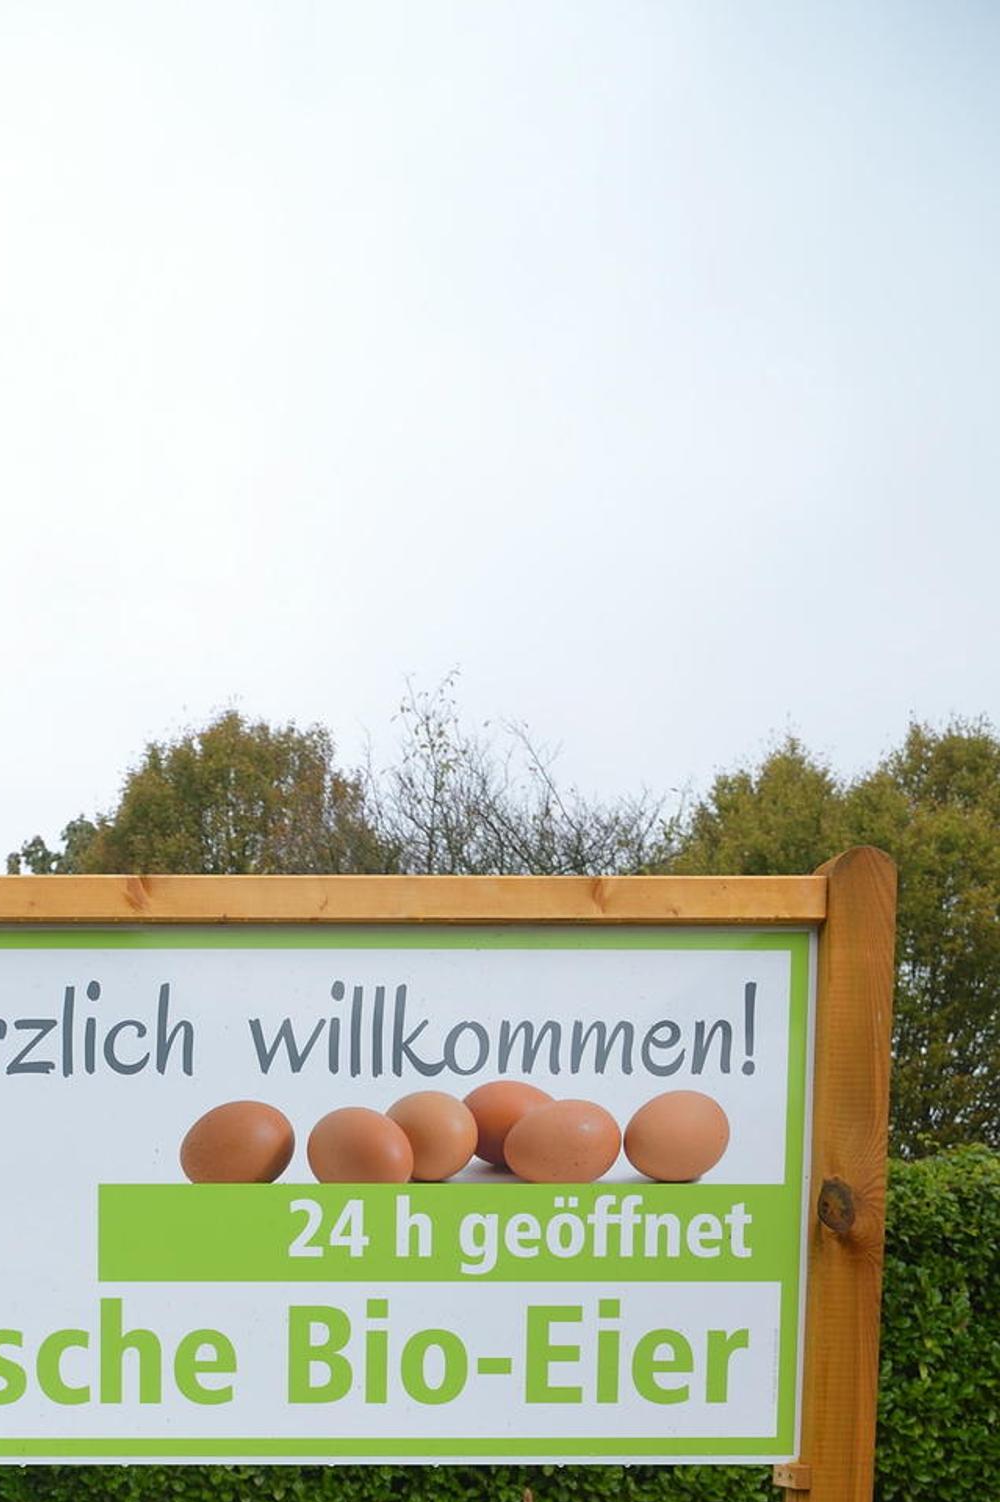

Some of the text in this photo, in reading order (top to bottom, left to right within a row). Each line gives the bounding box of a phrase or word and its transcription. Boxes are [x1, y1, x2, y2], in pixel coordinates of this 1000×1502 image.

[249, 981, 757, 1078] willkommen!
[287, 1193, 753, 1275] 24 h geöffnet
[289, 1299, 748, 1404] Bio-Eier
